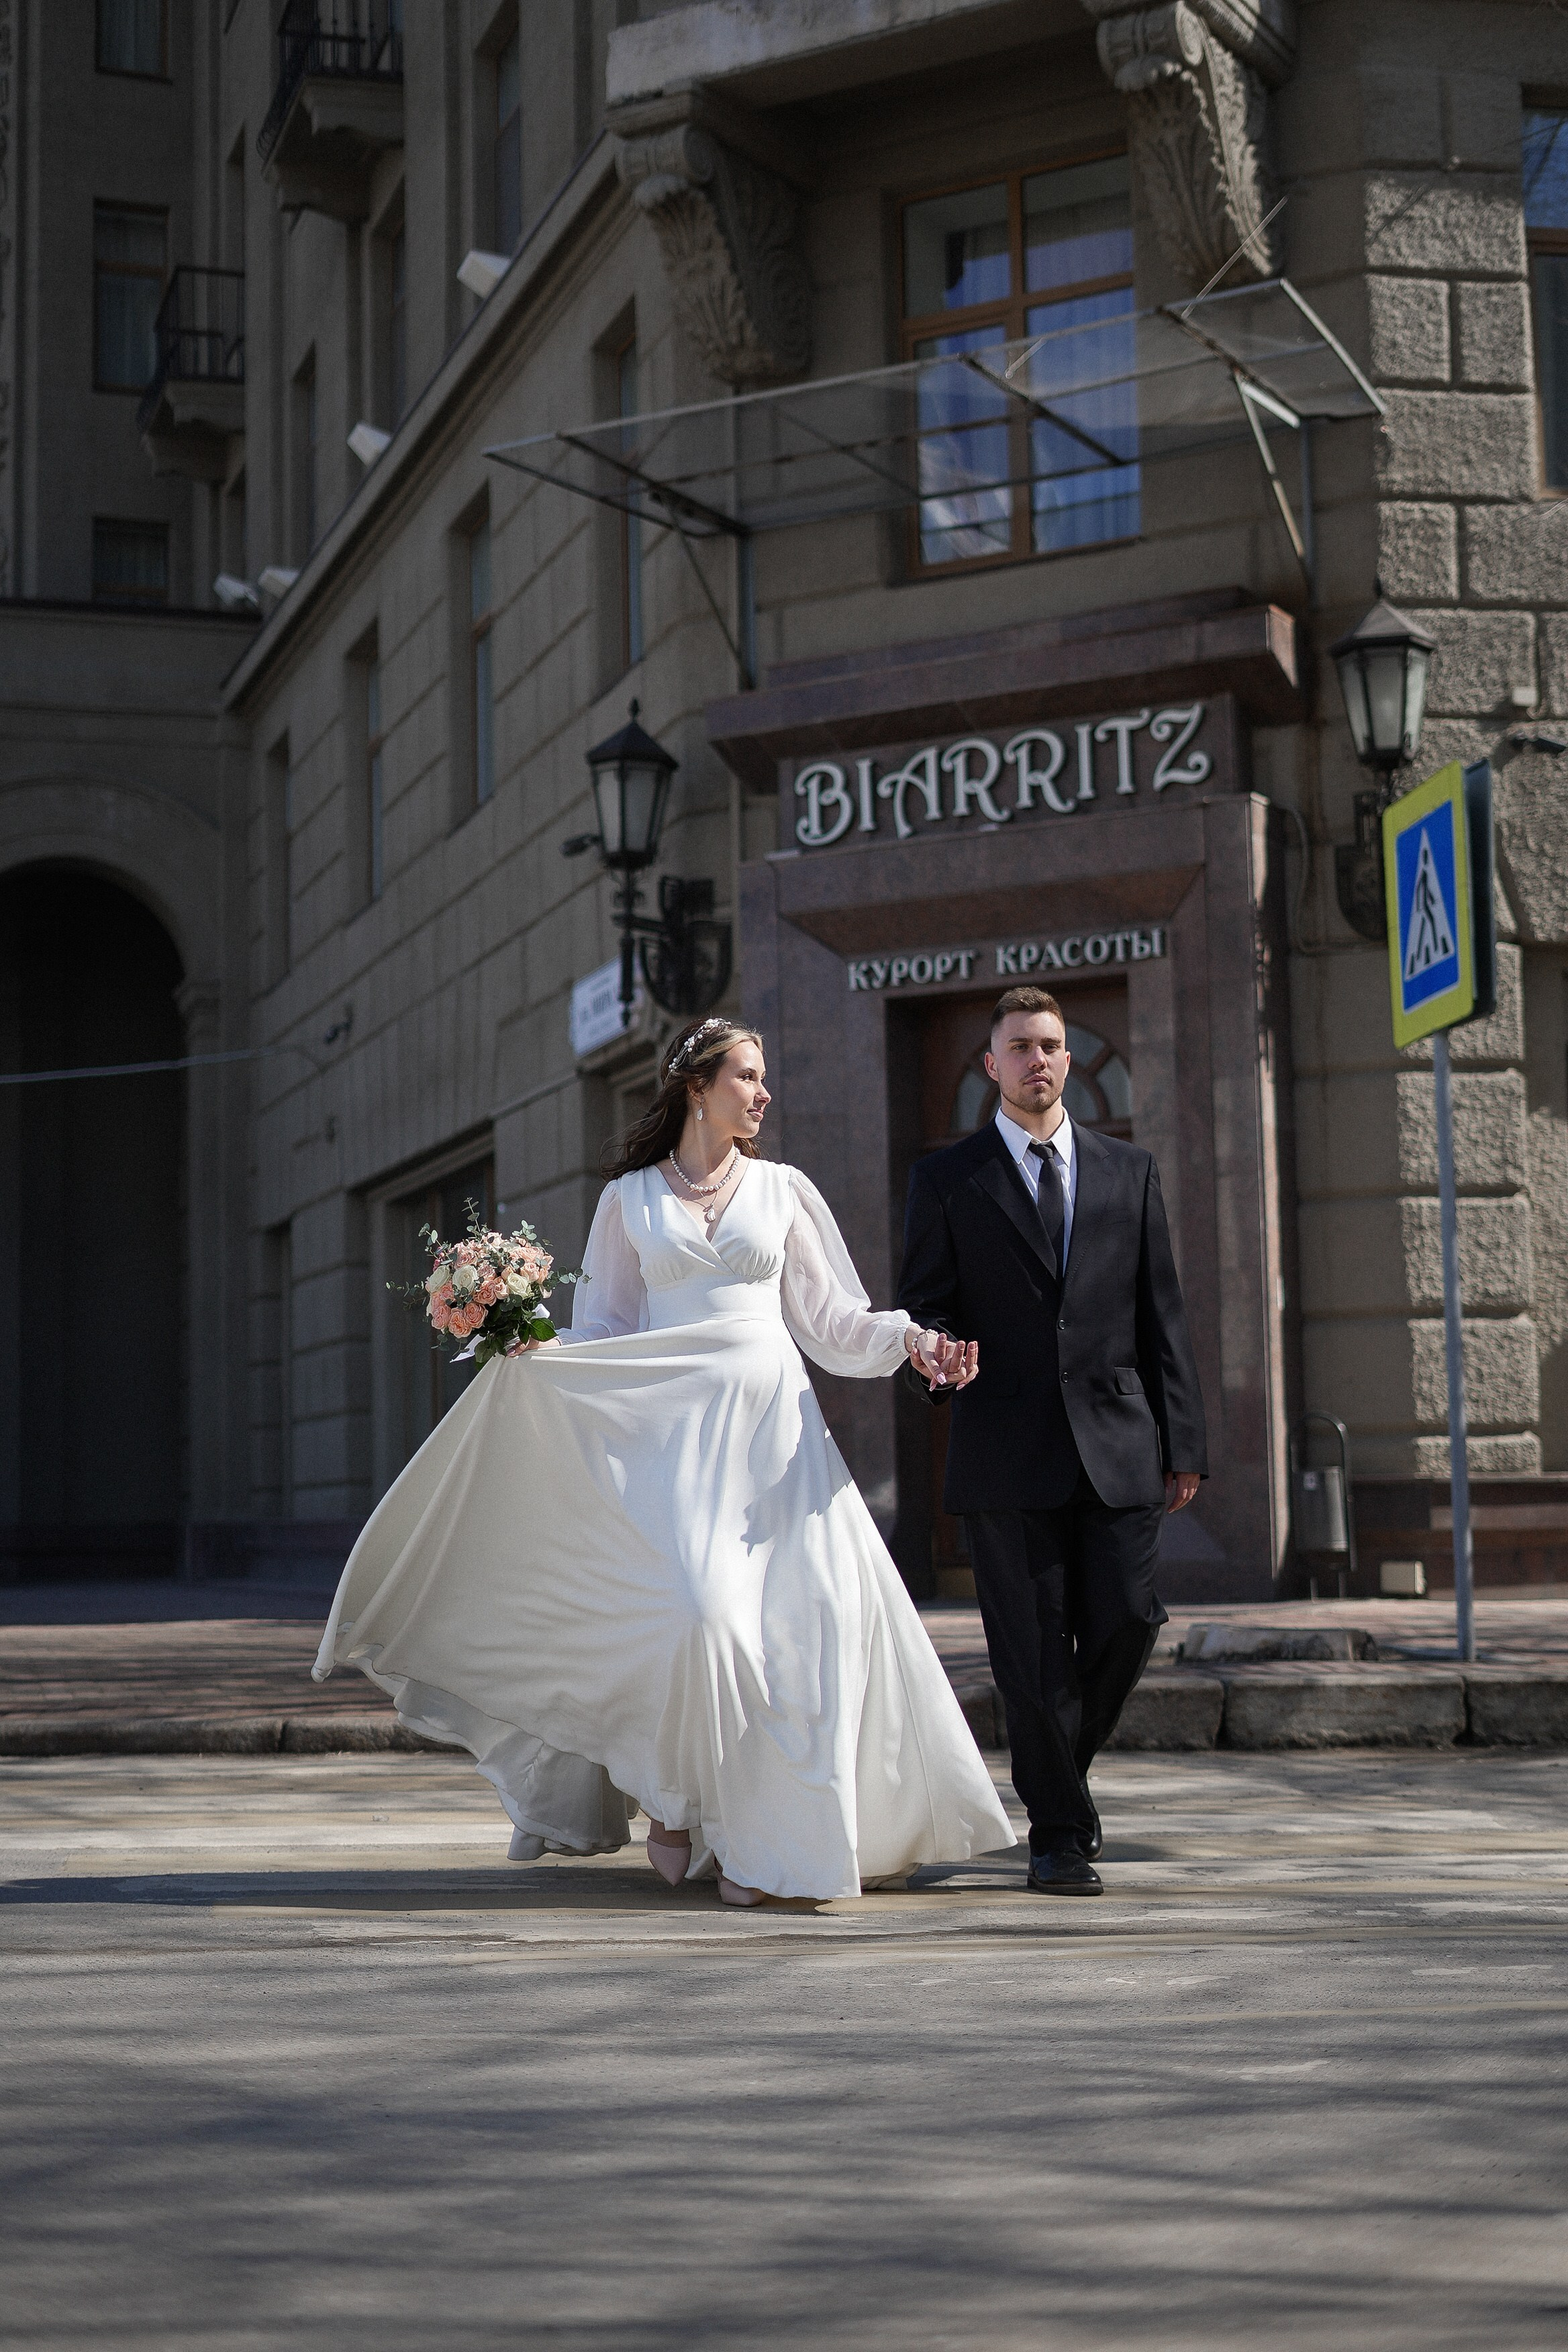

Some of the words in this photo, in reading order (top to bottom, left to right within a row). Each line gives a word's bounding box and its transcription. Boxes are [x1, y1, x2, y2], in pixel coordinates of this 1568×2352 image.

[794, 702, 1212, 846] BIARRITZ
[847, 948, 976, 991] КУРОРТ
[995, 926, 1163, 975] КРАСОТЫ
